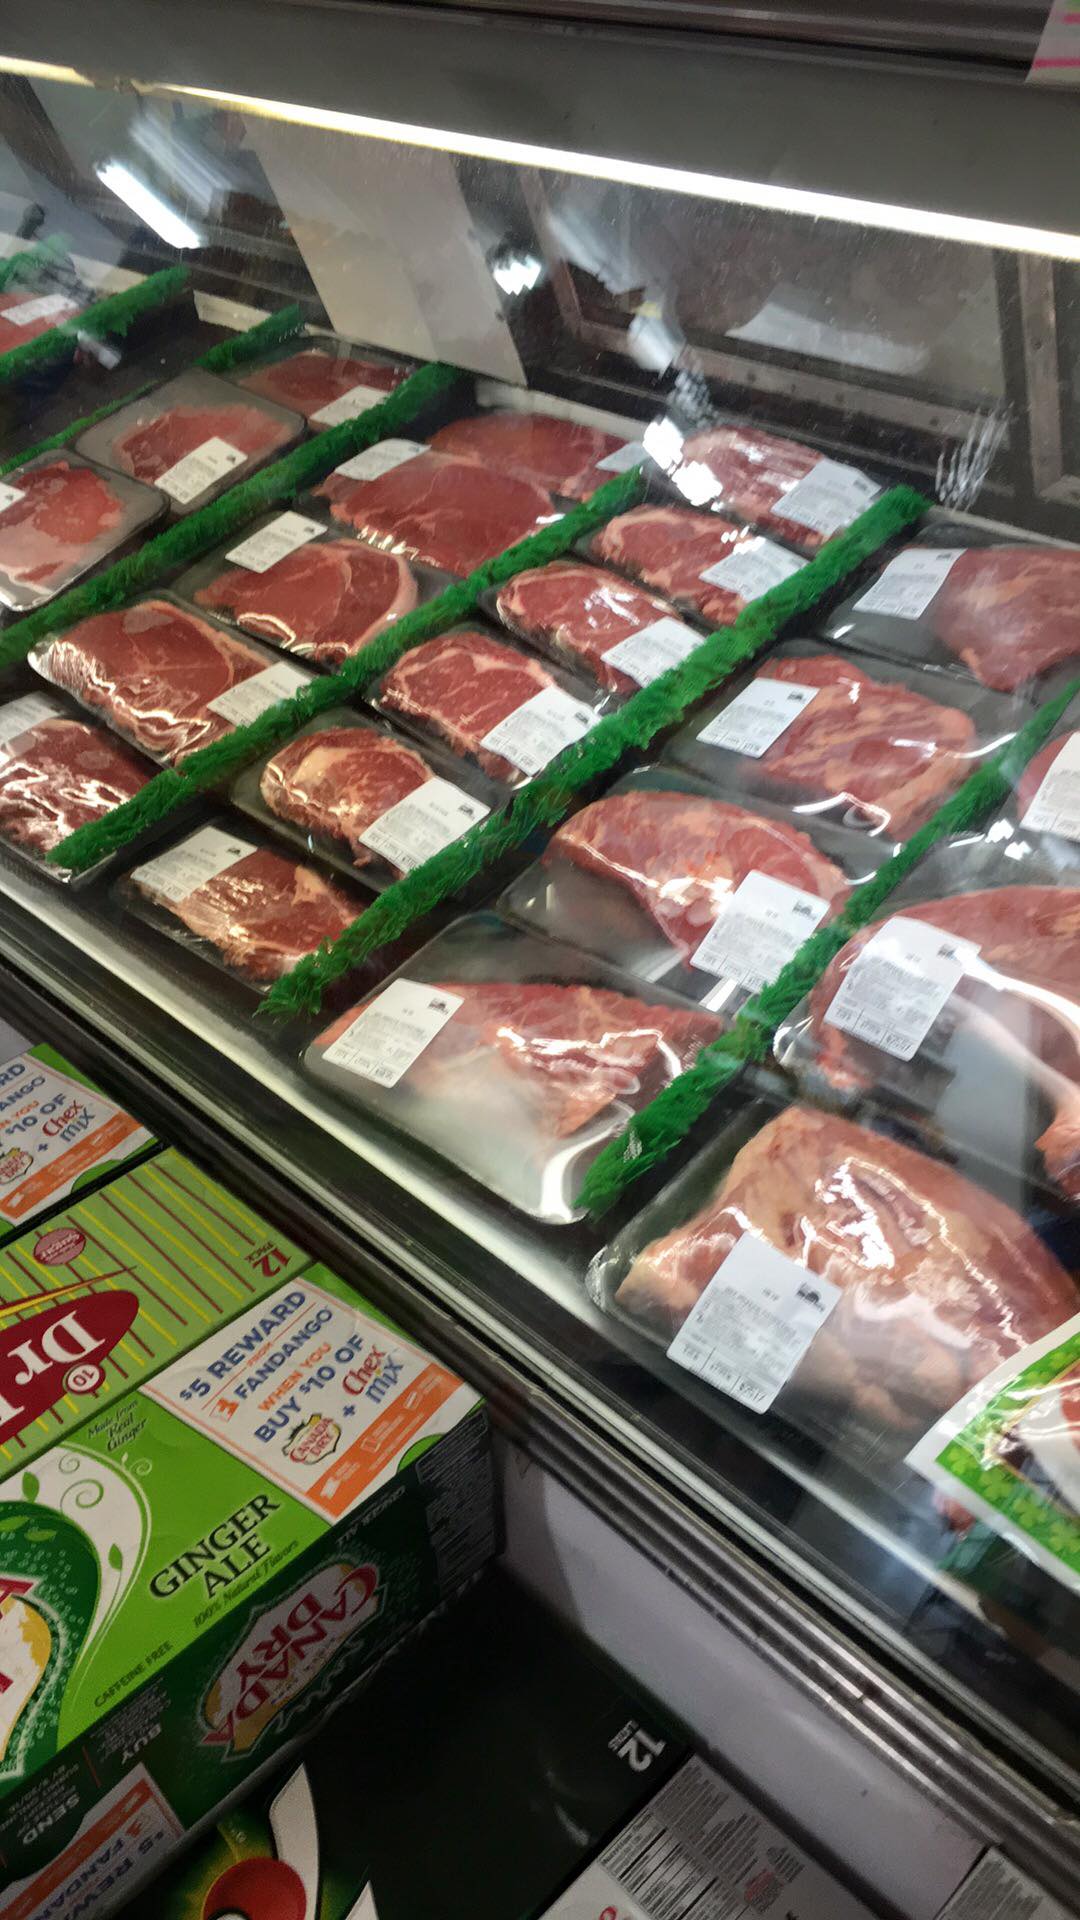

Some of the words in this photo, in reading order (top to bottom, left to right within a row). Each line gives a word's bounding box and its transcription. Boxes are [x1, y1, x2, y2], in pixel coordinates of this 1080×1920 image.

[40, 1093, 66, 1114] OF
[42, 1100, 84, 1136] Chex
[60, 1107, 95, 1142] mix
[255, 1253, 292, 1278] 12
[7, 1310, 106, 1385] Dr
[180, 1380, 211, 1400] $5
[207, 1291, 307, 1380] REWARD
[234, 1307, 333, 1400] FANDANGO
[342, 1345, 388, 1395] Chex
[72, 1369, 95, 1386] 10
[254, 1397, 303, 1443] BUY
[300, 1365, 336, 1395] $10
[335, 1335, 366, 1365] OF
[258, 1370, 303, 1412] WHEN
[299, 1343, 332, 1371] YOU
[364, 1358, 403, 1404] mix
[289, 1417, 334, 1464] CANADA
[310, 1432, 337, 1460] DRY
[149, 1493, 281, 1599] GINGER
[203, 1533, 271, 1598] ALE
[200, 1563, 380, 1746] CANADA
[236, 1591, 325, 1693] DRY
[94, 1663, 144, 1707] CAFFEINE
[141, 1641, 173, 1667] FREE
[121, 1723, 162, 1765] BUY
[617, 1729, 667, 1771] 12
[22, 1791, 81, 1844] SEND
